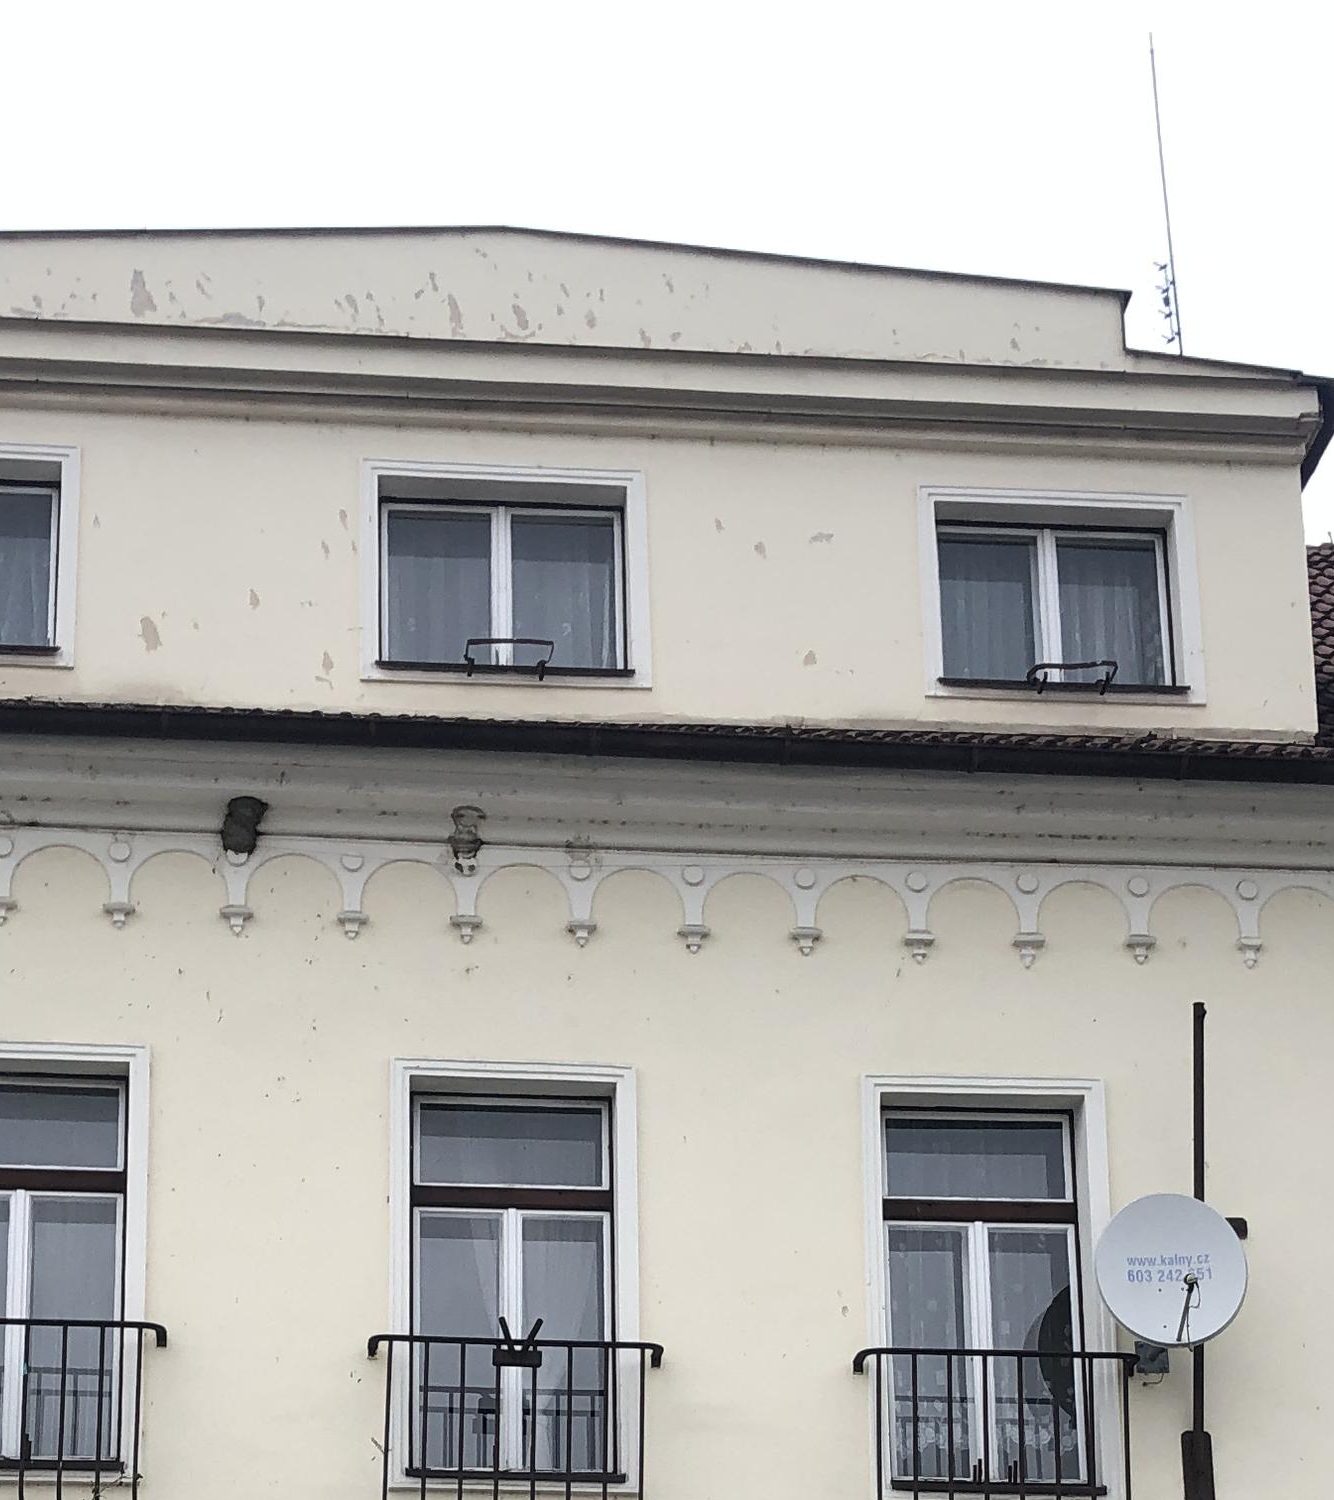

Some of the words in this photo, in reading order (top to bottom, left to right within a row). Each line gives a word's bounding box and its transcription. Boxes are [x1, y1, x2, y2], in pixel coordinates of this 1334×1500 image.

[1127, 1253, 1211, 1268] www.kalny.cz
[1127, 1268, 1153, 1283] 603
[1157, 1268, 1183, 1283] 242
